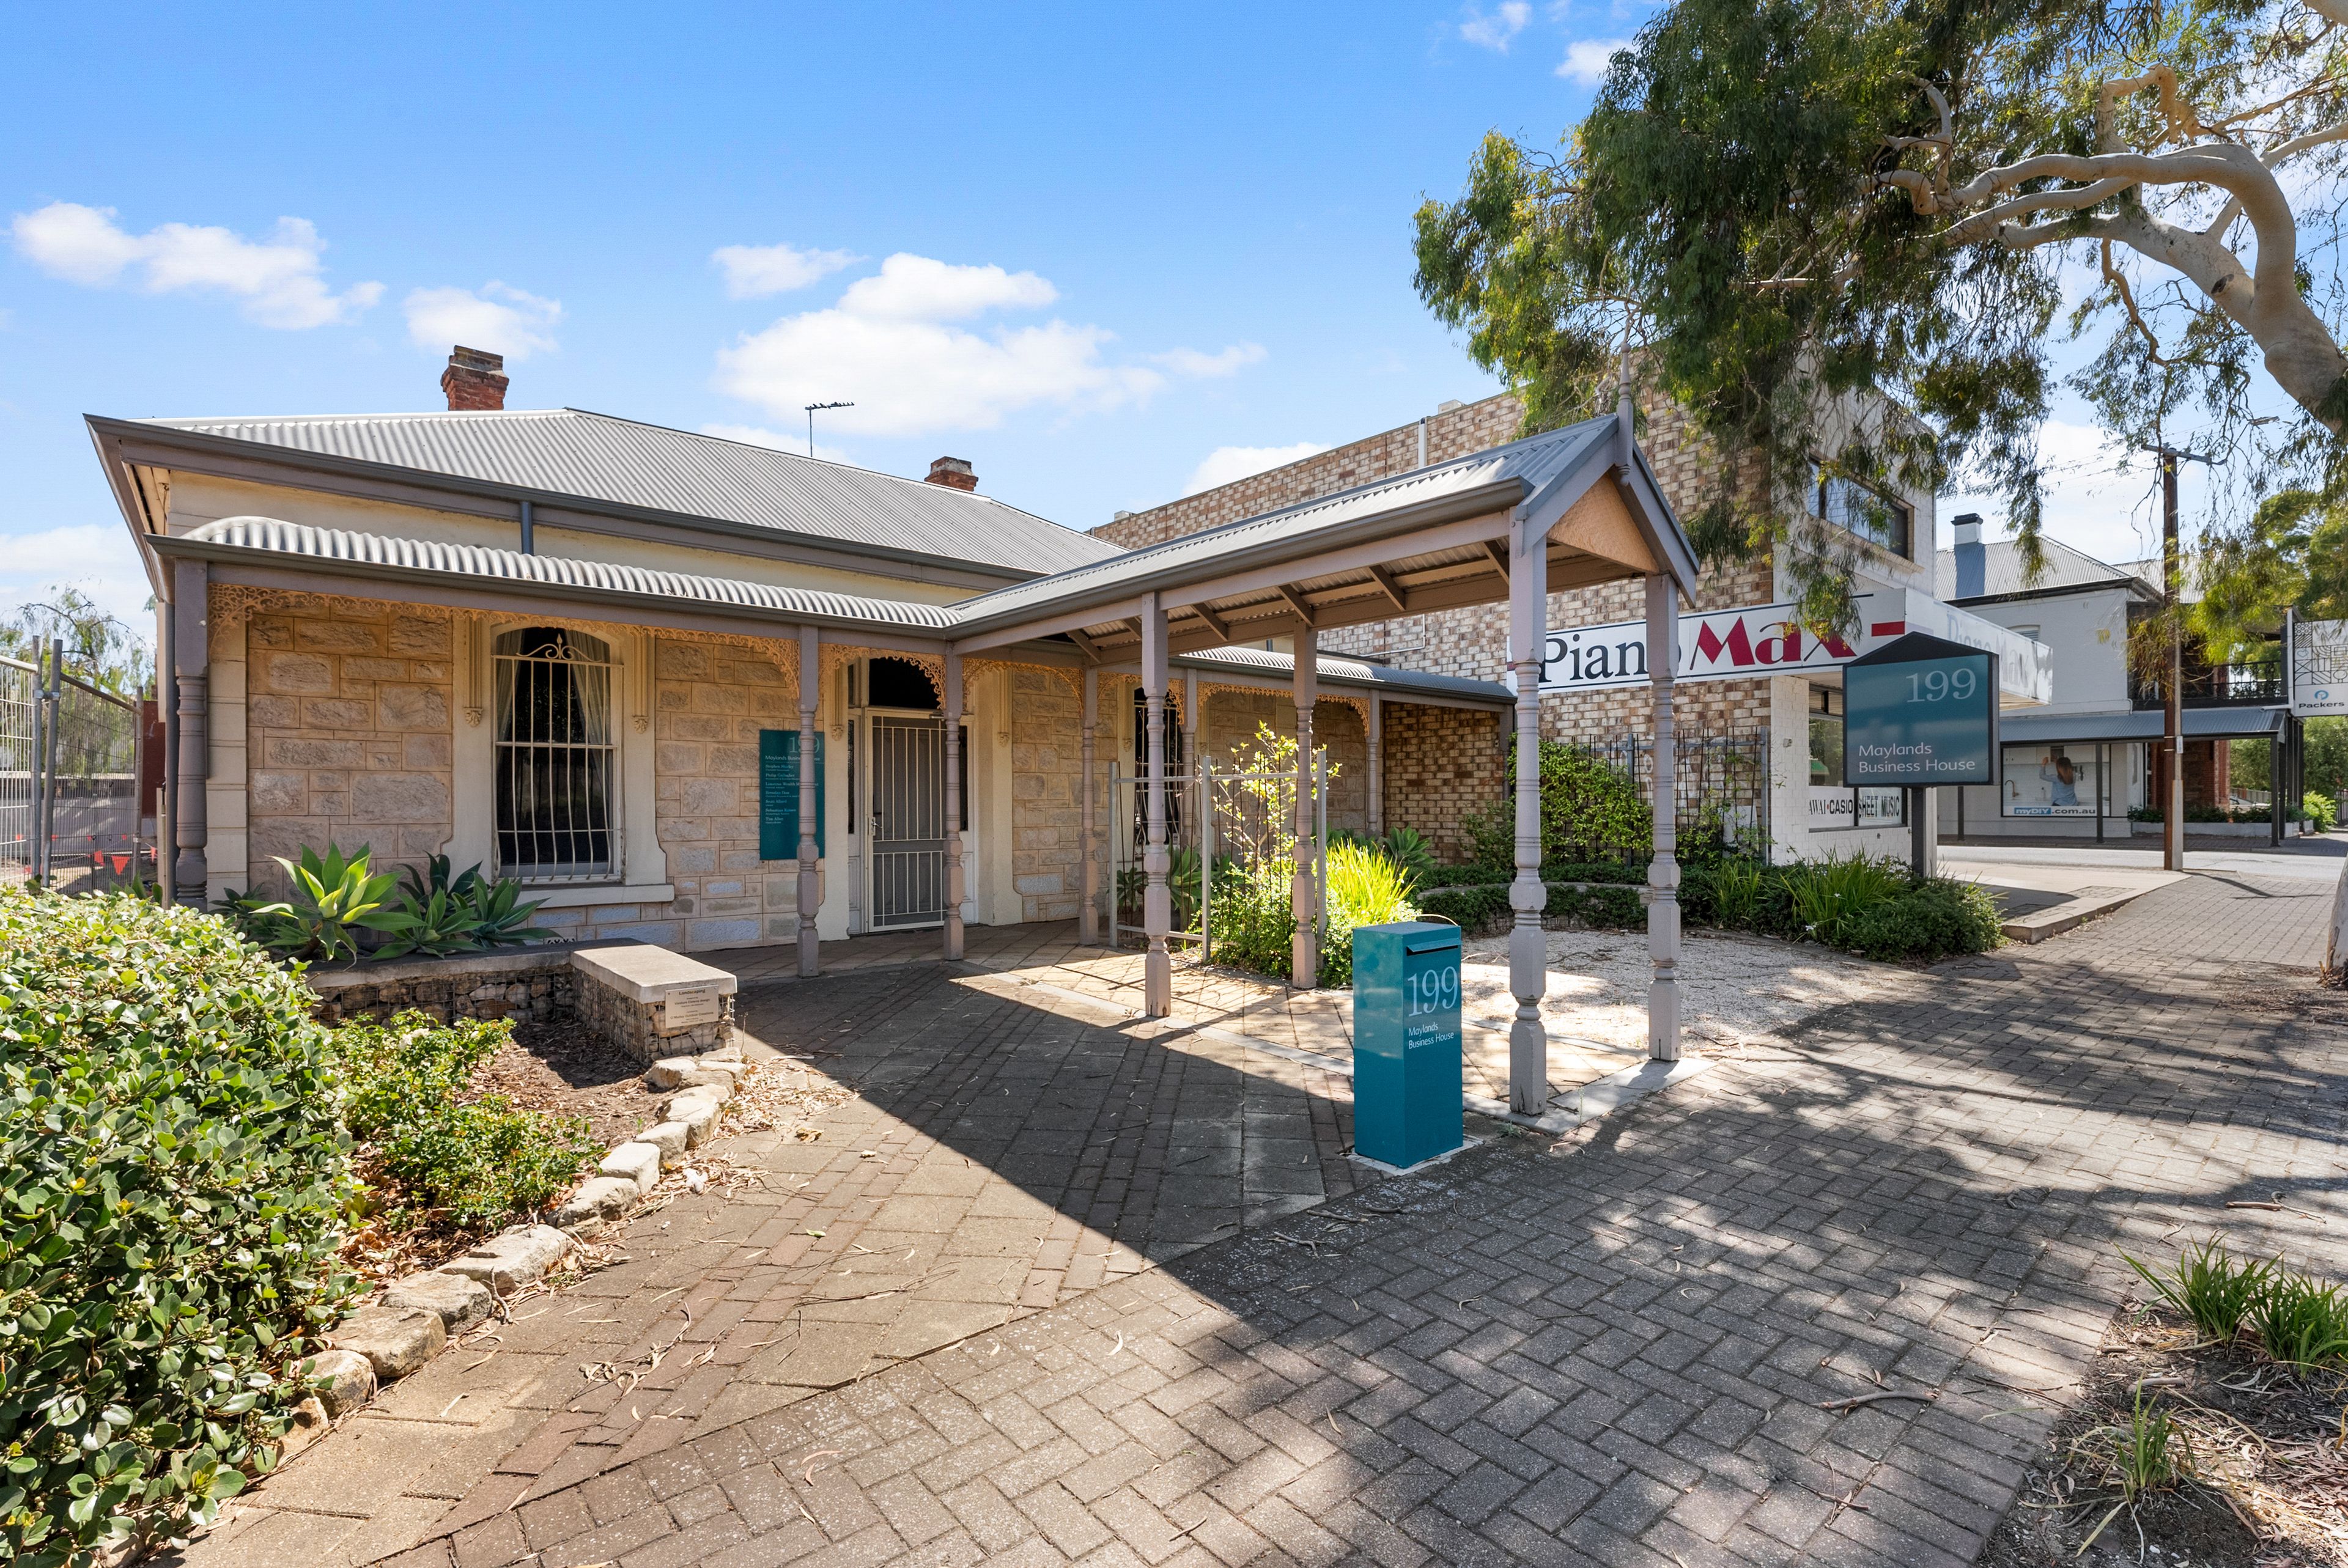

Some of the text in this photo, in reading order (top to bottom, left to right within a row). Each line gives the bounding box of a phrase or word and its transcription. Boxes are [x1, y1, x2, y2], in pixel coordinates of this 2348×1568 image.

[1538, 615, 1857, 683] Pian Max
[1905, 668, 1976, 703] 199
[1858, 742, 1932, 759] Maylands
[1859, 759, 1976, 773] Business House
[1829, 799, 1853, 814] CASIO
[1858, 796, 1899, 818] SHEET MUSIC
[1408, 966, 1458, 1017] 199
[1408, 1021, 1439, 1037] Maylands
[1408, 1032, 1455, 1050] Business House
